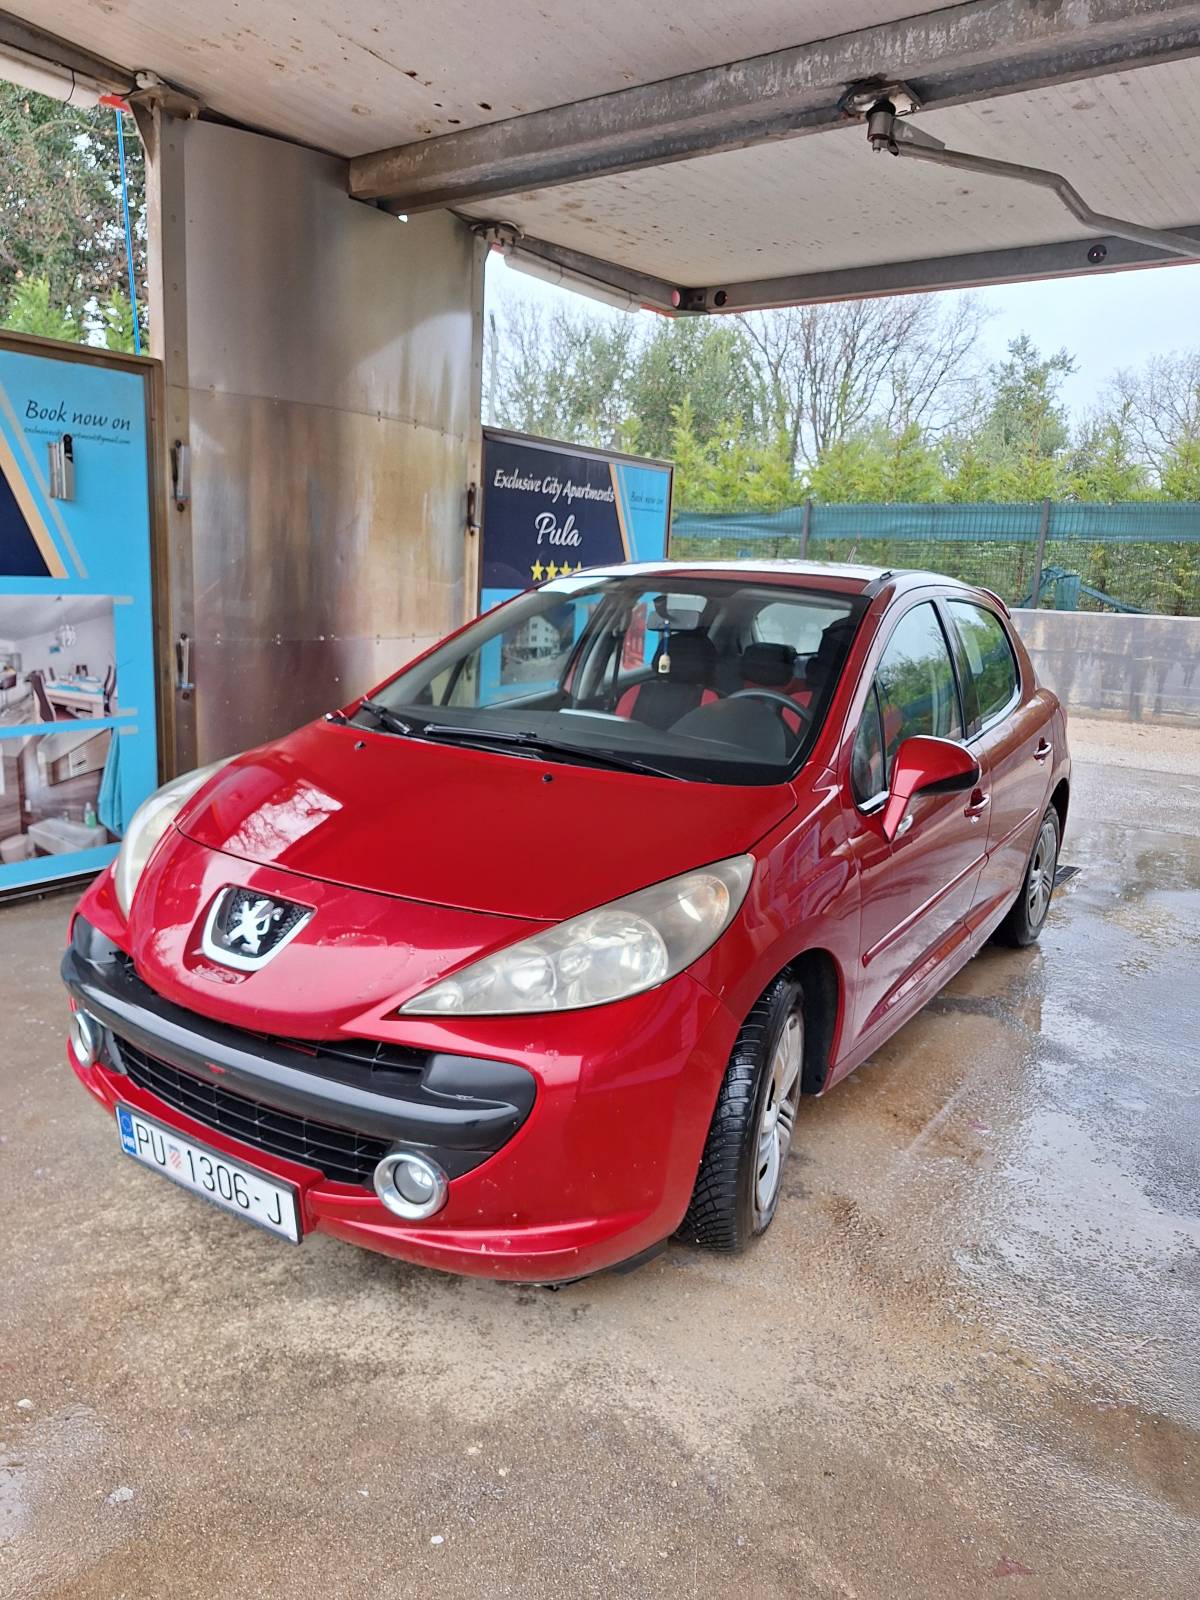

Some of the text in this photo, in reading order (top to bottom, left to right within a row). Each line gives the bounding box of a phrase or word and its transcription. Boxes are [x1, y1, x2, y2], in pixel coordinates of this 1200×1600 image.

[25, 399, 130, 431] Book now on
[494, 468, 615, 504] Exclusive City Apartments
[535, 512, 582, 546] Pula
[136, 1123, 282, 1225] PU 1306-J
